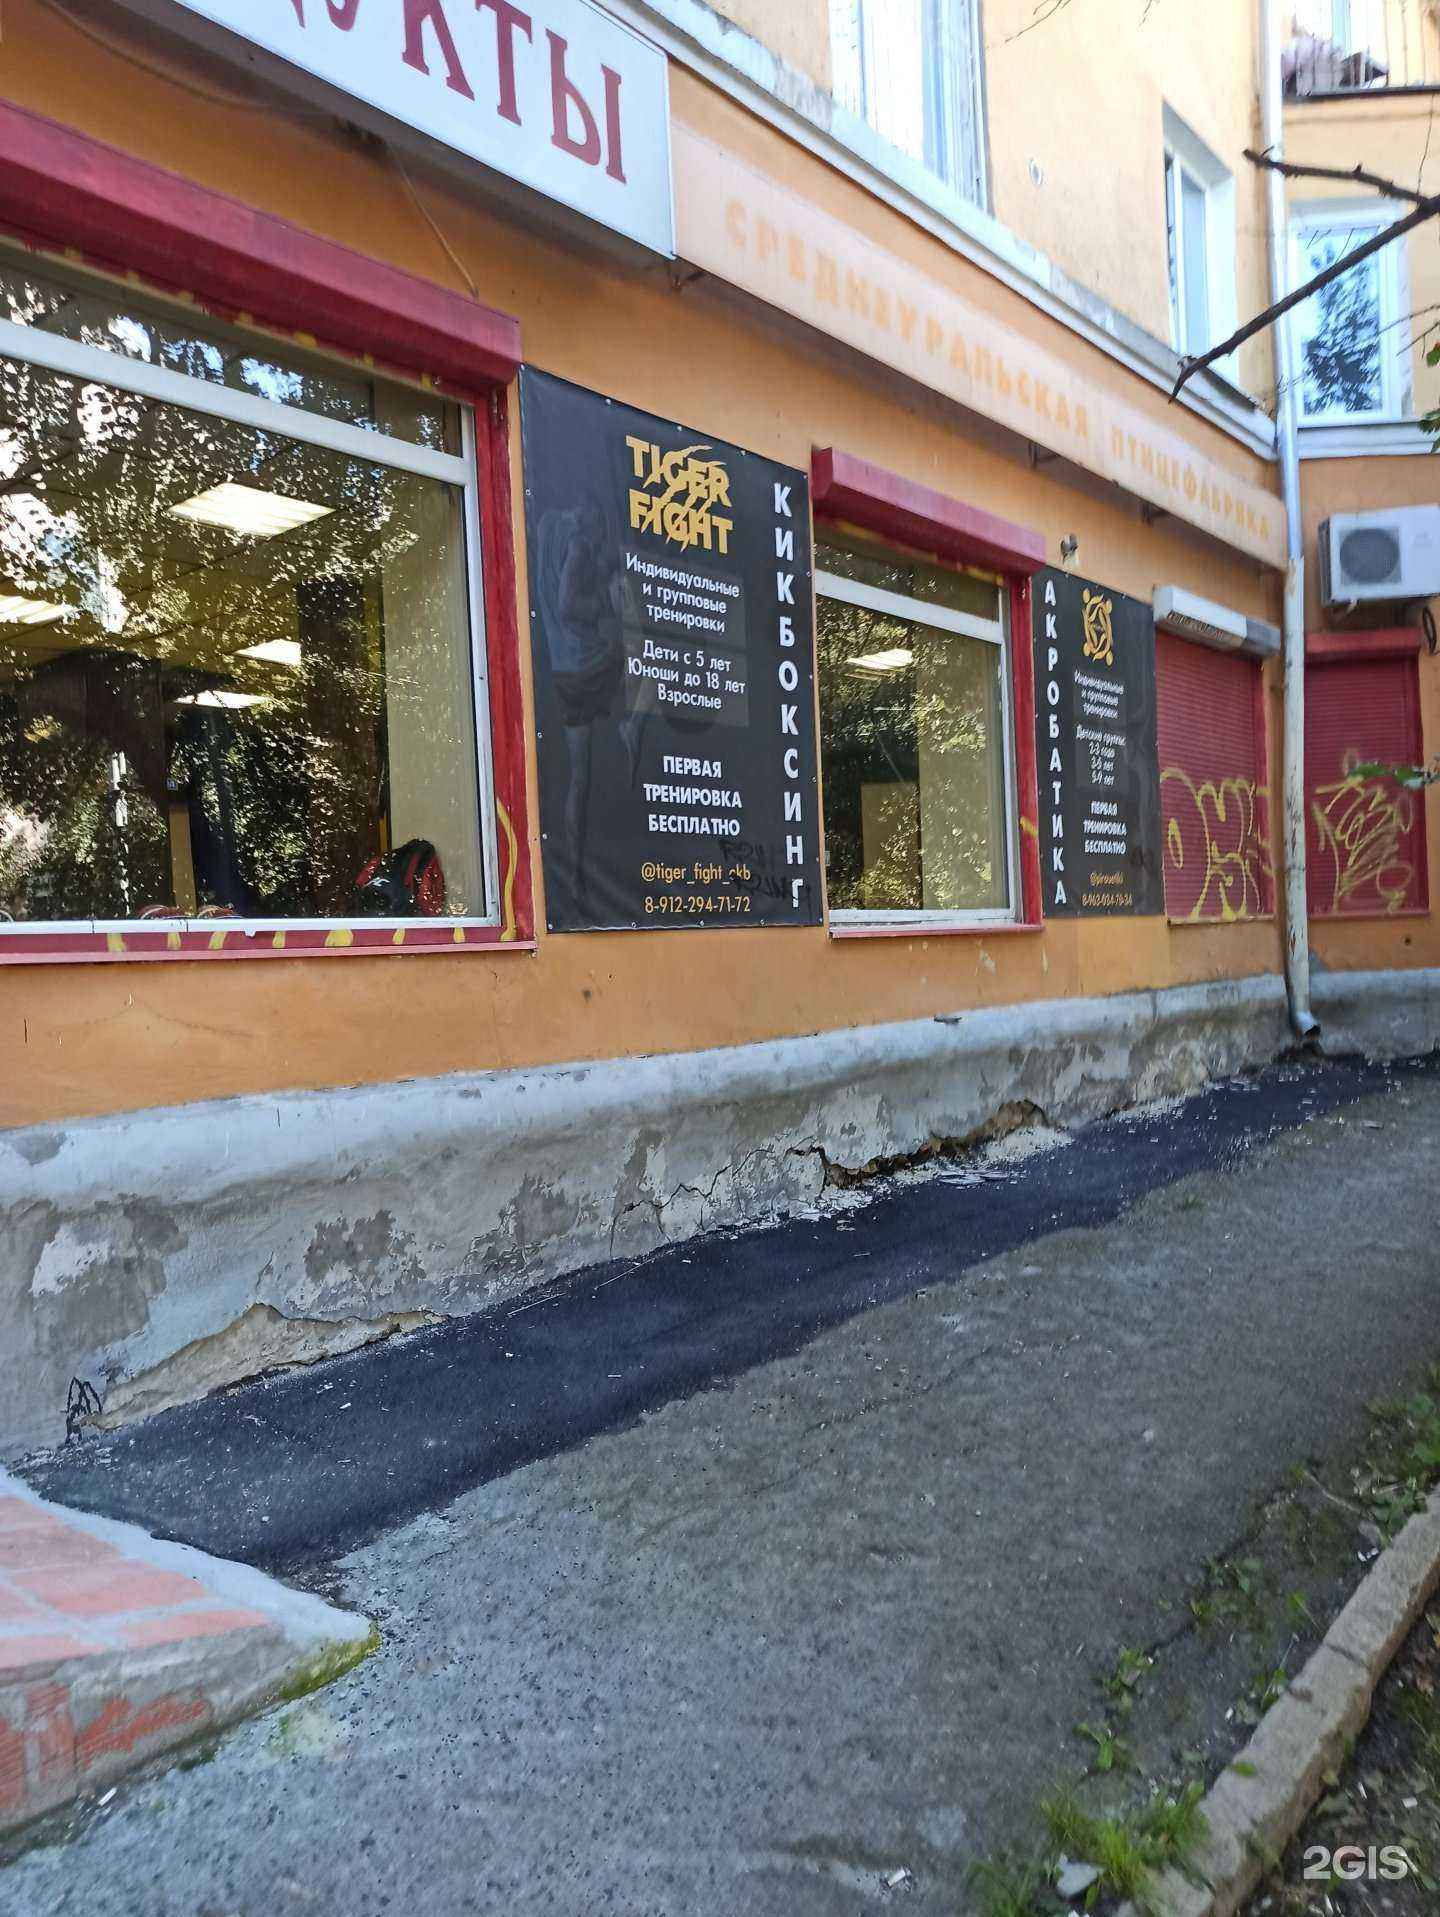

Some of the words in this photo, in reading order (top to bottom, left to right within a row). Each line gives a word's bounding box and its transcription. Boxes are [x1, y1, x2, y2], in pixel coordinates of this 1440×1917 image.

[625, 435, 732, 507] TIGER
[629, 488, 733, 555] FIGHT
[625, 552, 740, 598] Индивидуальные
[642, 583, 652, 595] и
[657, 587, 727, 614] групповые
[646, 604, 725, 633] тренировки
[643, 639, 679, 662] Дети
[683, 652, 691, 665] с
[695, 650, 704, 667] 5
[709, 658, 731, 673] лет
[627, 657, 679, 683] Юноши
[684, 672, 700, 688] до
[706, 672, 719, 689] 18
[725, 680, 746, 694] лет
[657, 683, 722, 709] Взрослые
[773, 482, 804, 908] КИКБОКСИНГ
[1045, 579, 1067, 905] АКРОБАТИКА
[662, 755, 722, 778] ПЕРВАЯ
[643, 783, 742, 808] ТРЕНИРОВКА
[648, 814, 740, 836] БЕСПЛАТНО
[1083, 820, 1127, 836] ТРЕНИРОВКА
[1084, 841, 1127, 855] БЕСПЛАТНО
[645, 896, 751, 913] 8-912-294-71-72
